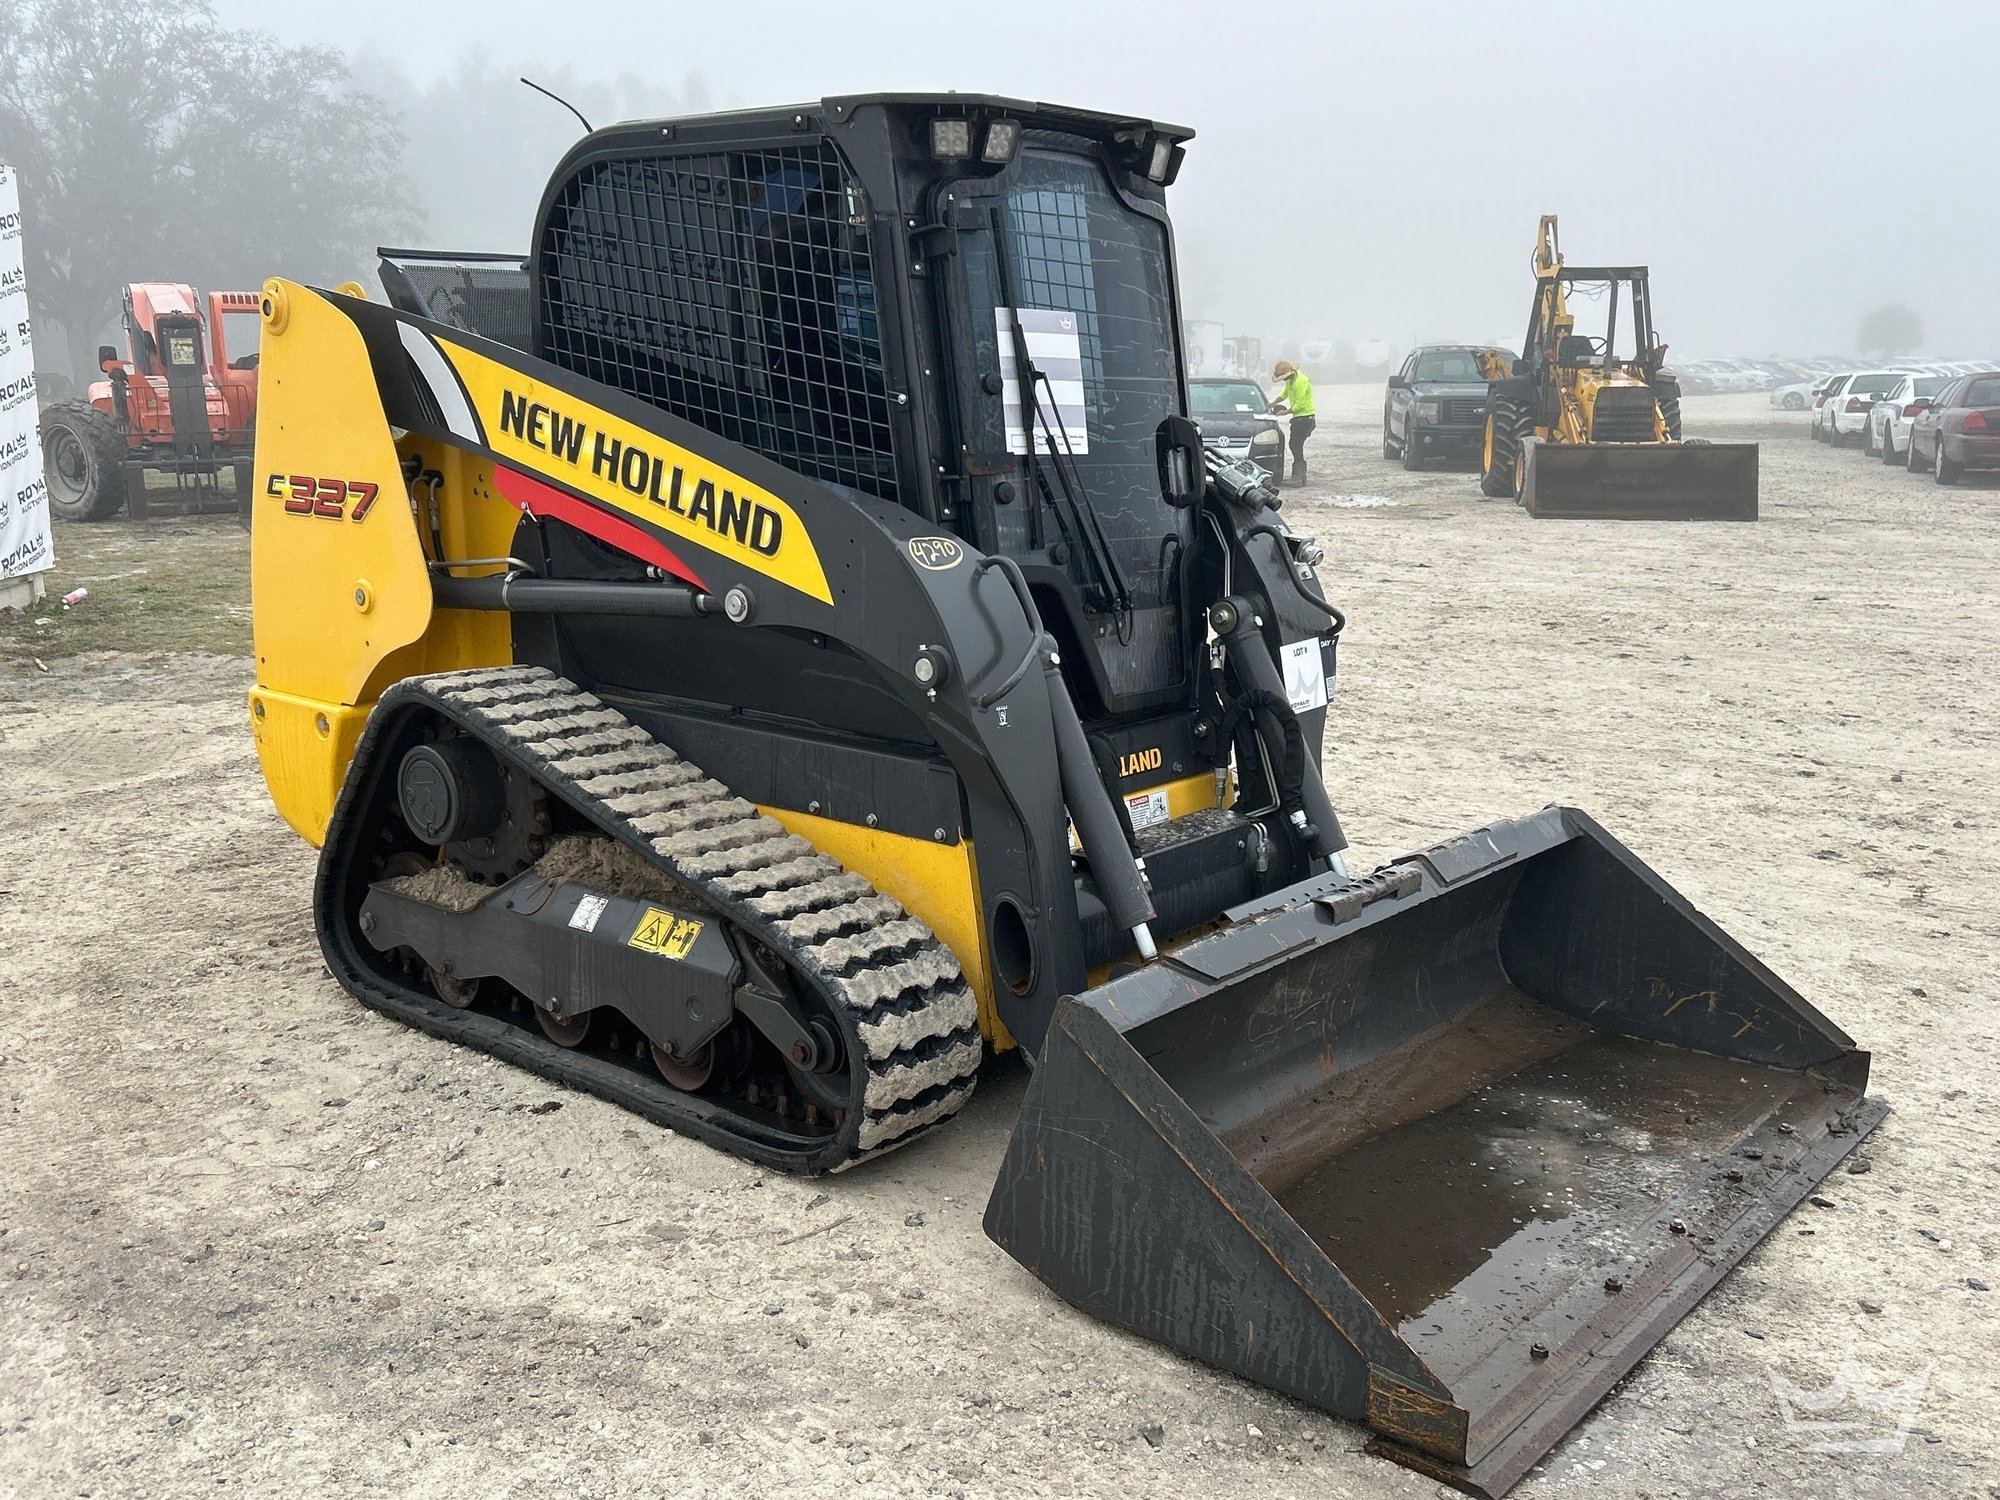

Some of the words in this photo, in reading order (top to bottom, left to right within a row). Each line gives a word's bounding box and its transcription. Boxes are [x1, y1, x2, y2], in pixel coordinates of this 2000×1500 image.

[500, 389, 585, 466] NEW
[592, 431, 783, 557] HOLLAND
[2, 540, 37, 572] ROYAL
[911, 540, 955, 566] 4290
[1293, 647, 1303, 657] LOT
